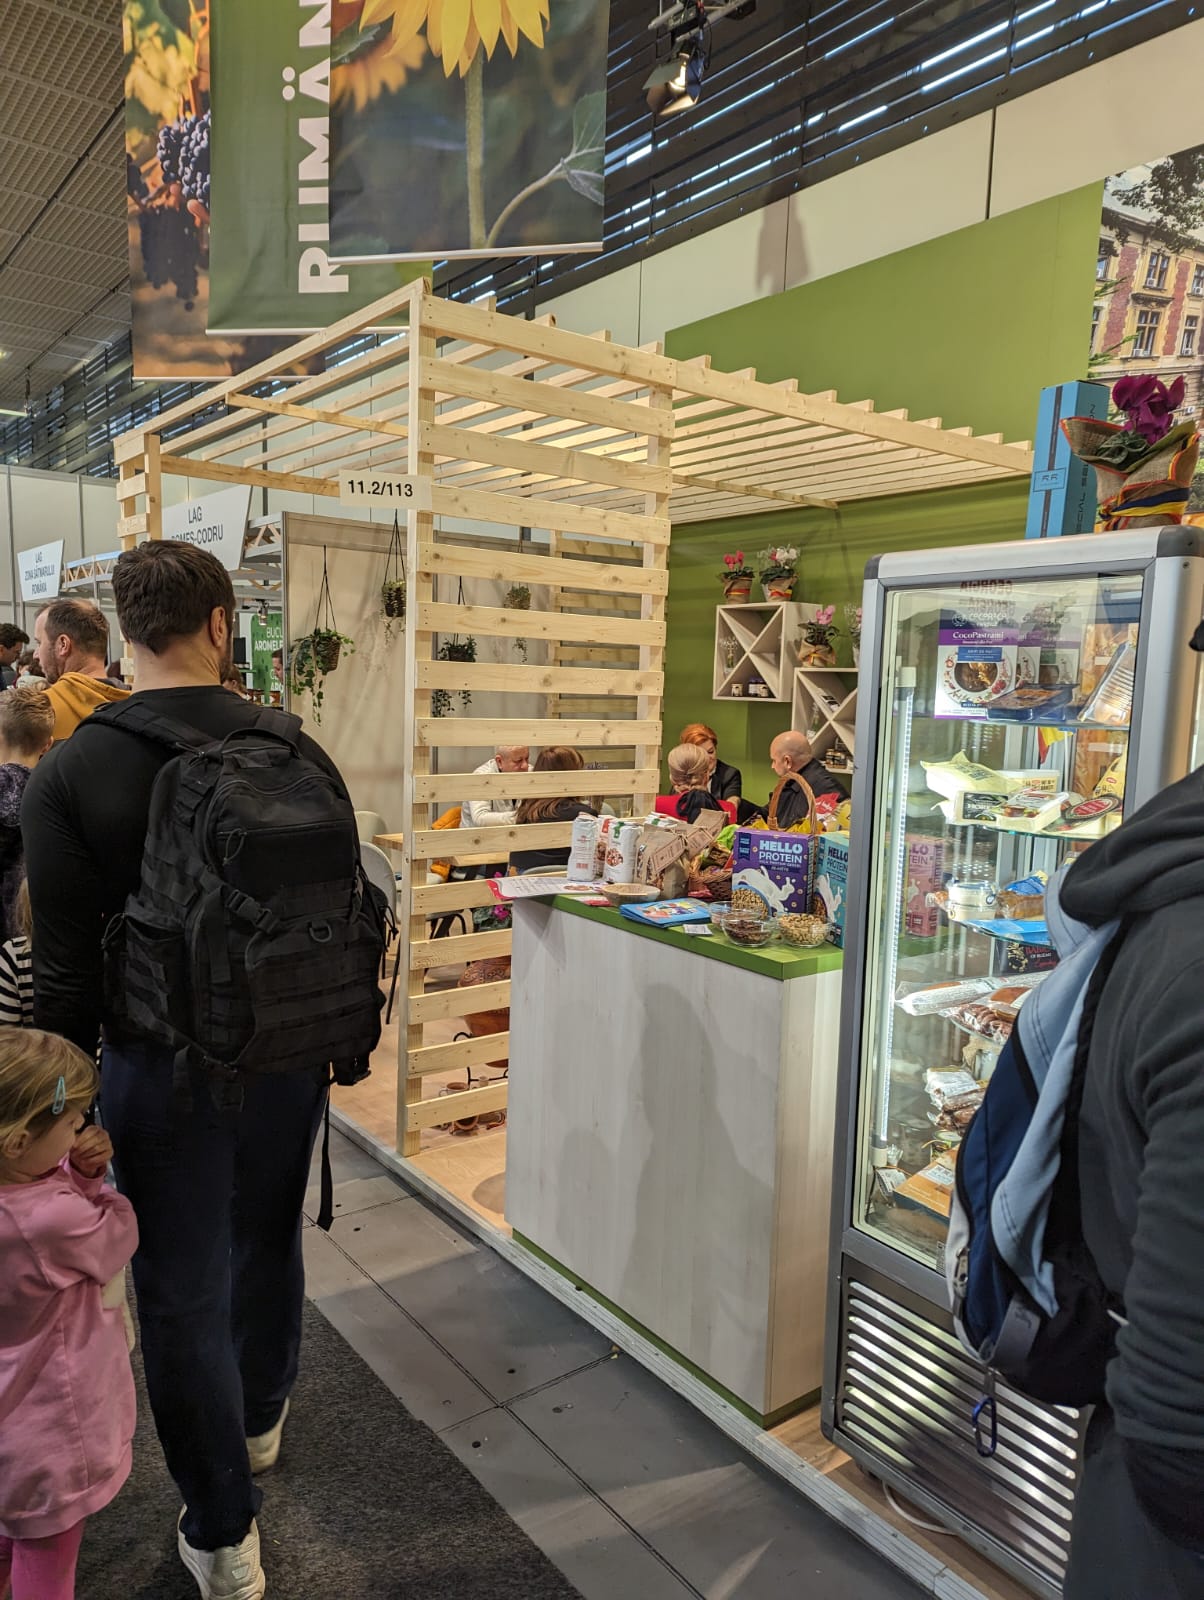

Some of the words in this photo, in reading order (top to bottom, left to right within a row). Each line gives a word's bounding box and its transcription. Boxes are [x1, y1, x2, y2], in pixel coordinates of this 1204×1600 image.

[348, 480, 413, 497] 11.2/113
[188, 506, 203, 524] LAG
[759, 840, 803, 854] HELLO
[828, 846, 849, 862] HELLO
[759, 851, 803, 864] PROTEIN
